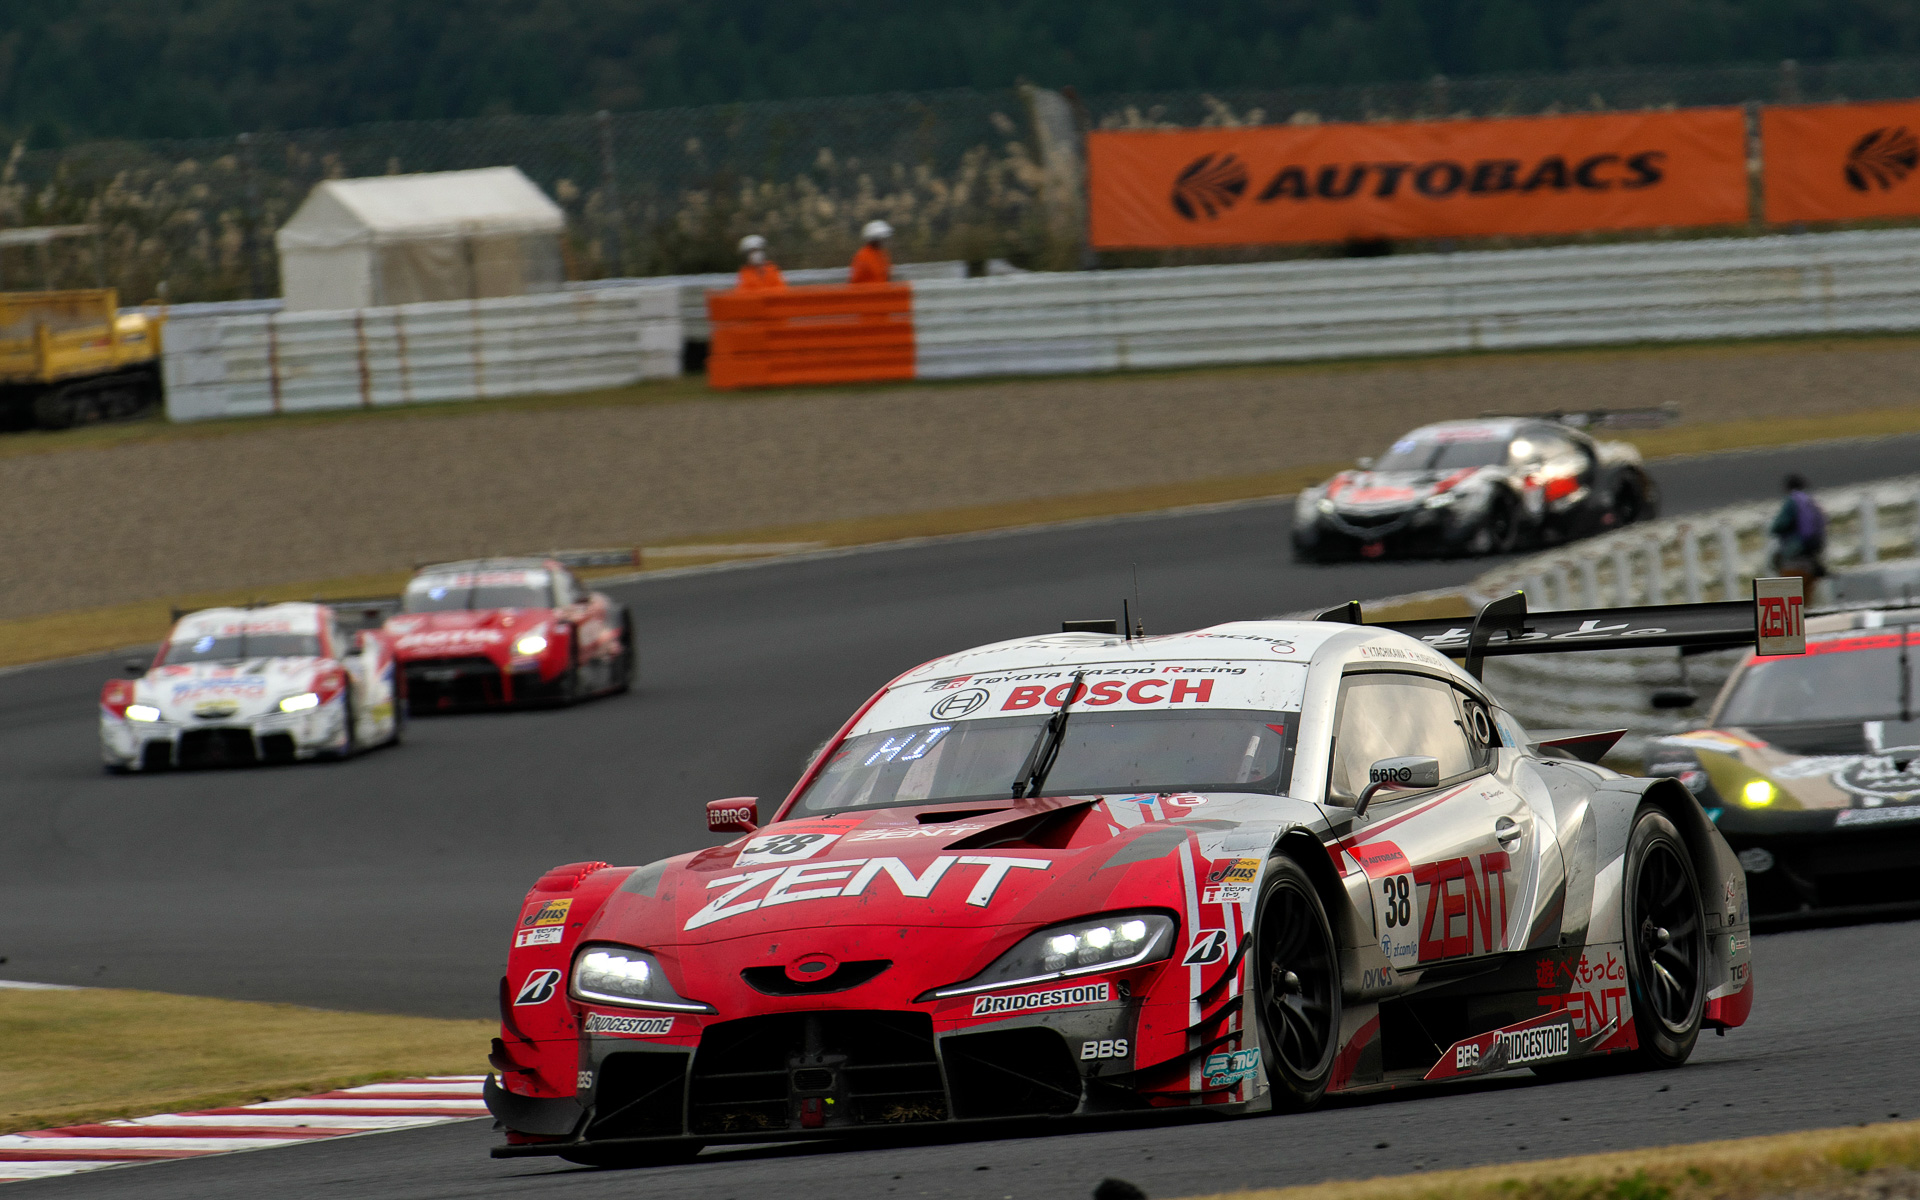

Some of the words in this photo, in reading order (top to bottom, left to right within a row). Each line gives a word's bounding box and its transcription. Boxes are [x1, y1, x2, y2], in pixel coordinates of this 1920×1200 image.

[1257, 150, 1668, 203] AUTOBACS
[1758, 596, 1803, 638] ZENT
[973, 671, 1060, 685] TOYOTA
[1067, 666, 1156, 677] GAZOO
[1161, 666, 1248, 675] Racing
[1000, 678, 1214, 711] BOSCH
[709, 807, 751, 825] EBBRO
[743, 833, 825, 855] 38
[847, 828, 980, 842] ZENT
[1368, 851, 1404, 864] AUTOBACS
[683, 856, 1052, 931] ZENT
[1383, 875, 1411, 928] 38
[1412, 851, 1512, 963] ZENT
[1535, 952, 1625, 988] 遊べ、もっと。
[972, 983, 1109, 1016] BRIDGESTONE
[585, 1012, 675, 1034] BRIDGESTONE
[1080, 1039, 1128, 1060] BBS
[1456, 1044, 1480, 1068] BBS
[577, 1070, 593, 1089] BS
